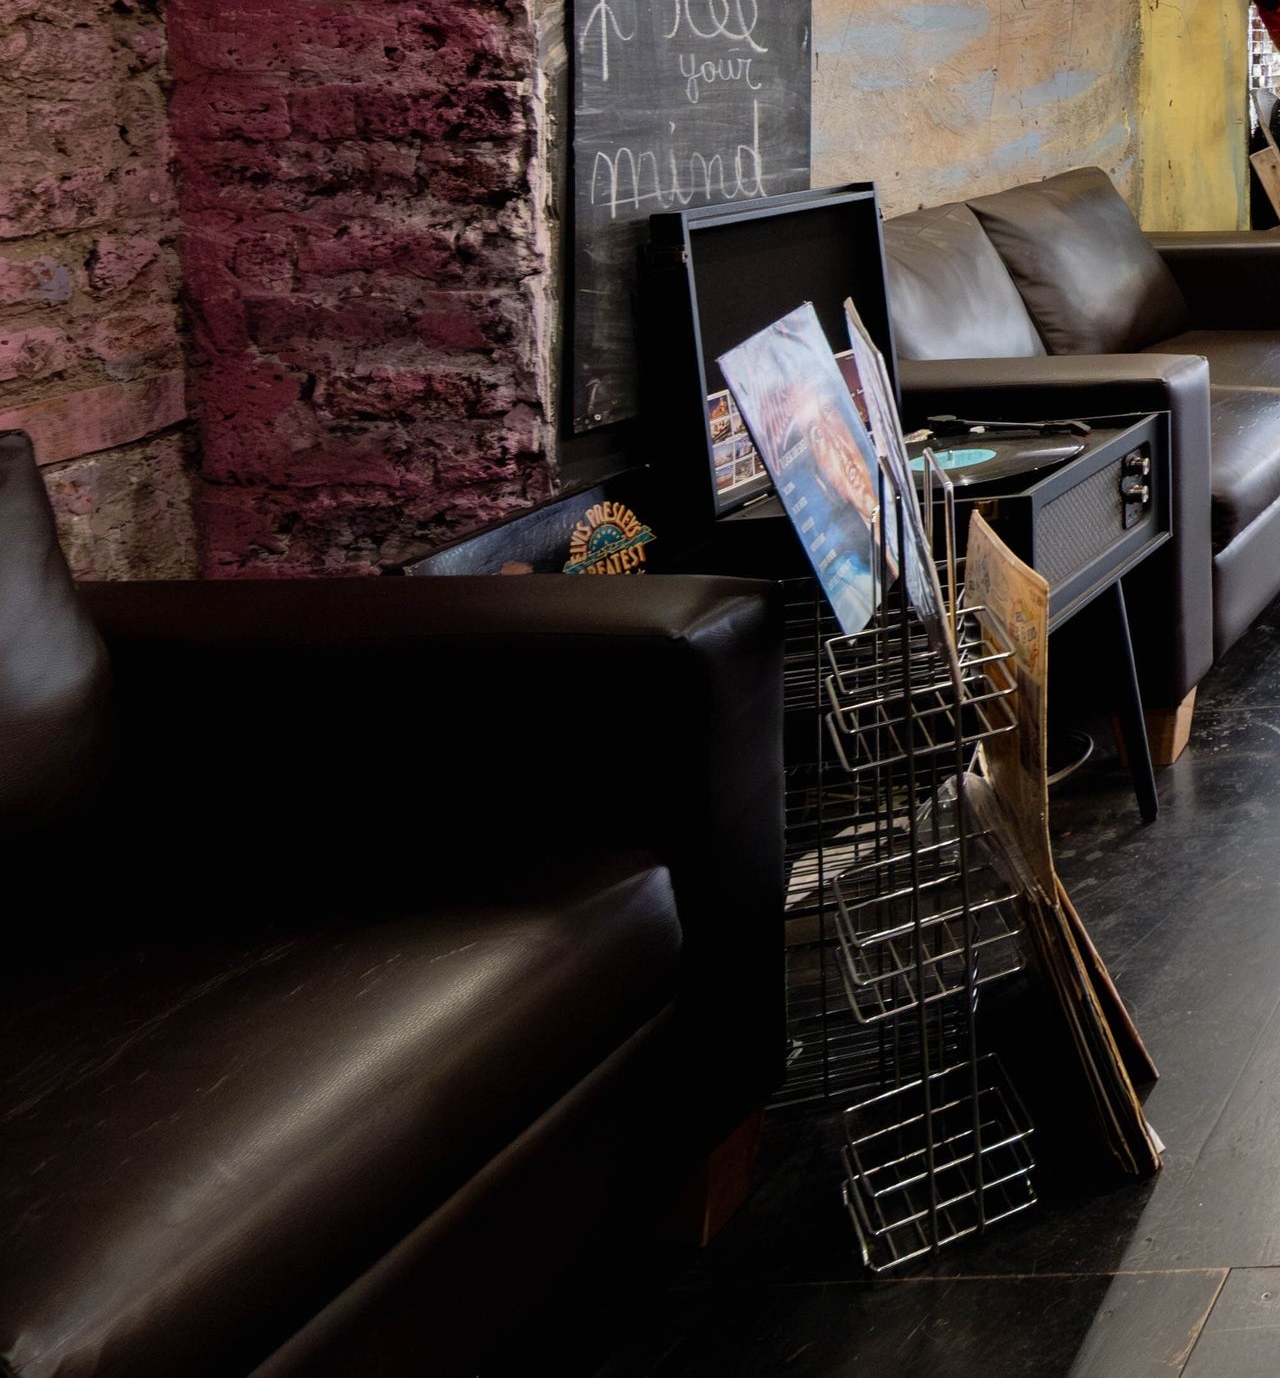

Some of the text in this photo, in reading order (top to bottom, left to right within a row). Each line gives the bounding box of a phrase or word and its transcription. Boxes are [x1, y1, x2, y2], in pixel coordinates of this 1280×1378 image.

[679, 51, 762, 104] your
[591, 98, 769, 219] mind
[569, 520, 592, 564] ELVIS
[578, 542, 647, 574] REATEST
